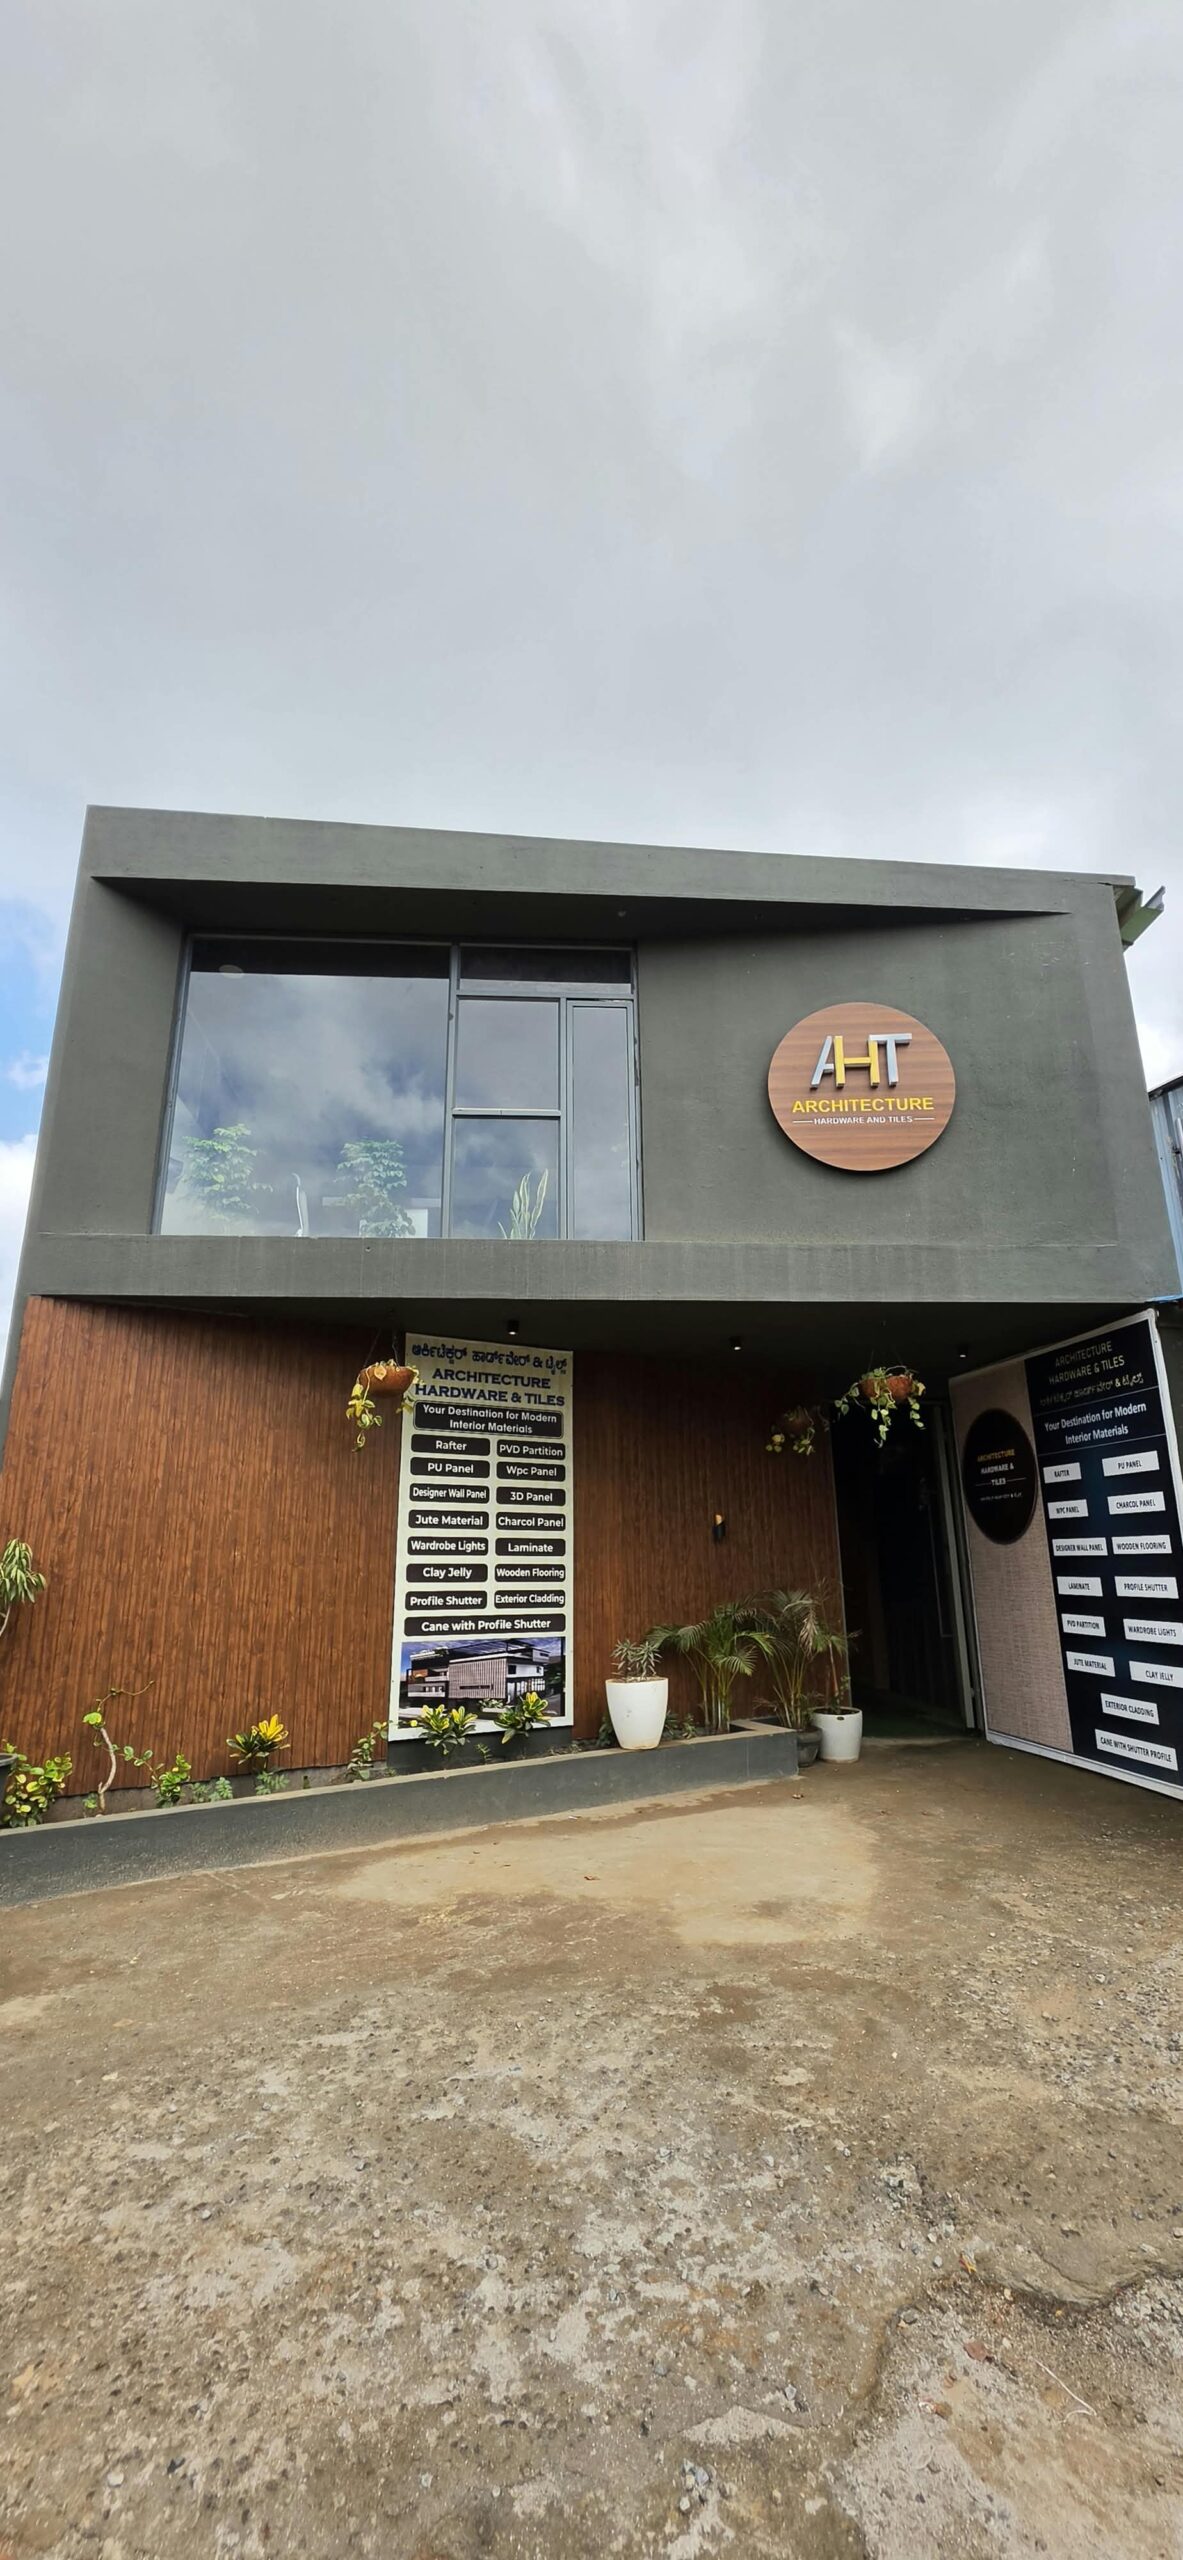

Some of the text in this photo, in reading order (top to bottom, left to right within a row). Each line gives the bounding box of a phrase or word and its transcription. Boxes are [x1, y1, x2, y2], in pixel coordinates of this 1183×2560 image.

[811, 1033, 912, 1088] AHT
[792, 1097, 934, 1113] ARCHITECTURE
[814, 1117, 865, 1125] HARDWARE
[867, 1116, 886, 1124] AND
[1055, 1341, 1112, 1367] ARCHITECTURE
[533, 1357, 543, 1368] &
[1049, 1355, 1125, 1384] HARDWARE & TILES
[432, 1368, 551, 1389] ARCHITECTURE
[1115, 1377, 1121, 1387] &
[415, 1384, 565, 1406] HARDWARE & TILES
[423, 1404, 557, 1423] Your Destination for Modern
[1044, 1403, 1147, 1432] Your Destination for Modern
[450, 1420, 533, 1434] Interior Materials
[1065, 1424, 1129, 1445] Interior Materials
[435, 1440, 467, 1451] Rafter
[499, 1444, 563, 1456] PVD Partition
[427, 1462, 474, 1474] PU Panel
[506, 1465, 557, 1476] Wpc Panel
[1118, 1460, 1142, 1470] PU PANEL
[1054, 1469, 1070, 1478] RAFTER
[413, 1486, 487, 1499] Designer Wall Panel
[510, 1491, 553, 1502] 3D Panel
[1056, 1506, 1065, 1514] WPC
[1116, 1499, 1156, 1509] CHARCOL PANEL
[415, 1514, 483, 1525] Jute Material
[498, 1516, 564, 1528] Charcol Panel
[411, 1540, 486, 1553] Wardrobe Lights
[508, 1543, 553, 1552] Laminate
[423, 1567, 472, 1579] Clay Jelly
[496, 1568, 565, 1579] Wooden Flooring
[1124, 1583, 1143, 1591] PROFILE
[410, 1595, 482, 1606] Profile Shutter
[495, 1594, 565, 1604] Exterior Cladding
[421, 1619, 551, 1632] Cane with Profile Shutter
[1076, 1621, 1100, 1629] PARTITION
[1128, 1626, 1177, 1637] WARDROBE LIGHTS
[1074, 1658, 1107, 1670] JUTE MATERIAL
[1146, 1670, 1173, 1681] CLAY JELLY
[1105, 1700, 1154, 1718] EXTERIOR CLADDING
[1100, 1737, 1172, 1763] CANE WITH SHUTTER PROFILE
